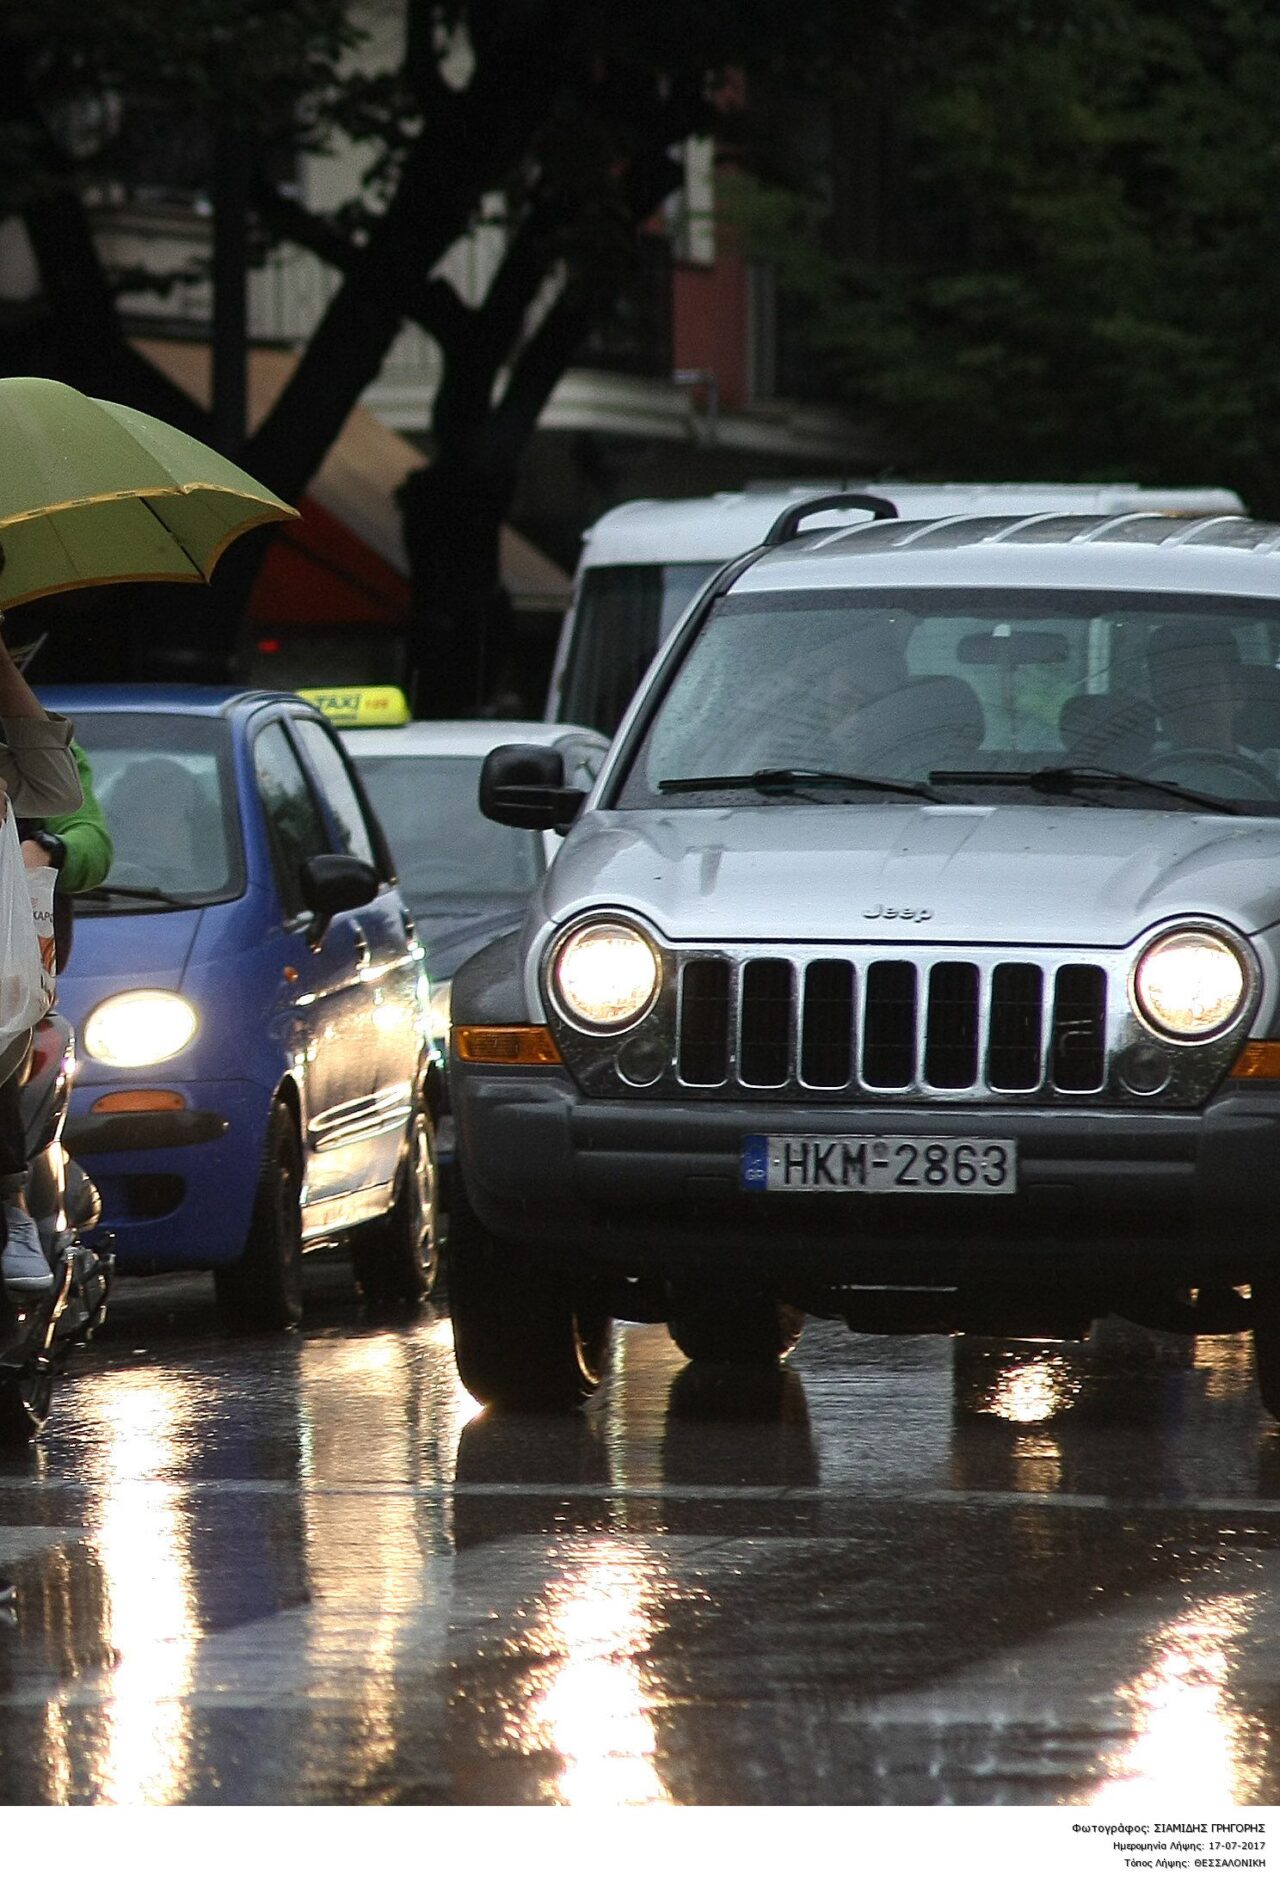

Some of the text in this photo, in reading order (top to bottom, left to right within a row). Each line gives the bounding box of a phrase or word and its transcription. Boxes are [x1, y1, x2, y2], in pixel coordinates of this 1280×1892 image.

[314, 693, 361, 709] TAXI
[862, 904, 933, 923] Jeep
[784, 1142, 1007, 1187] HKM-2863
